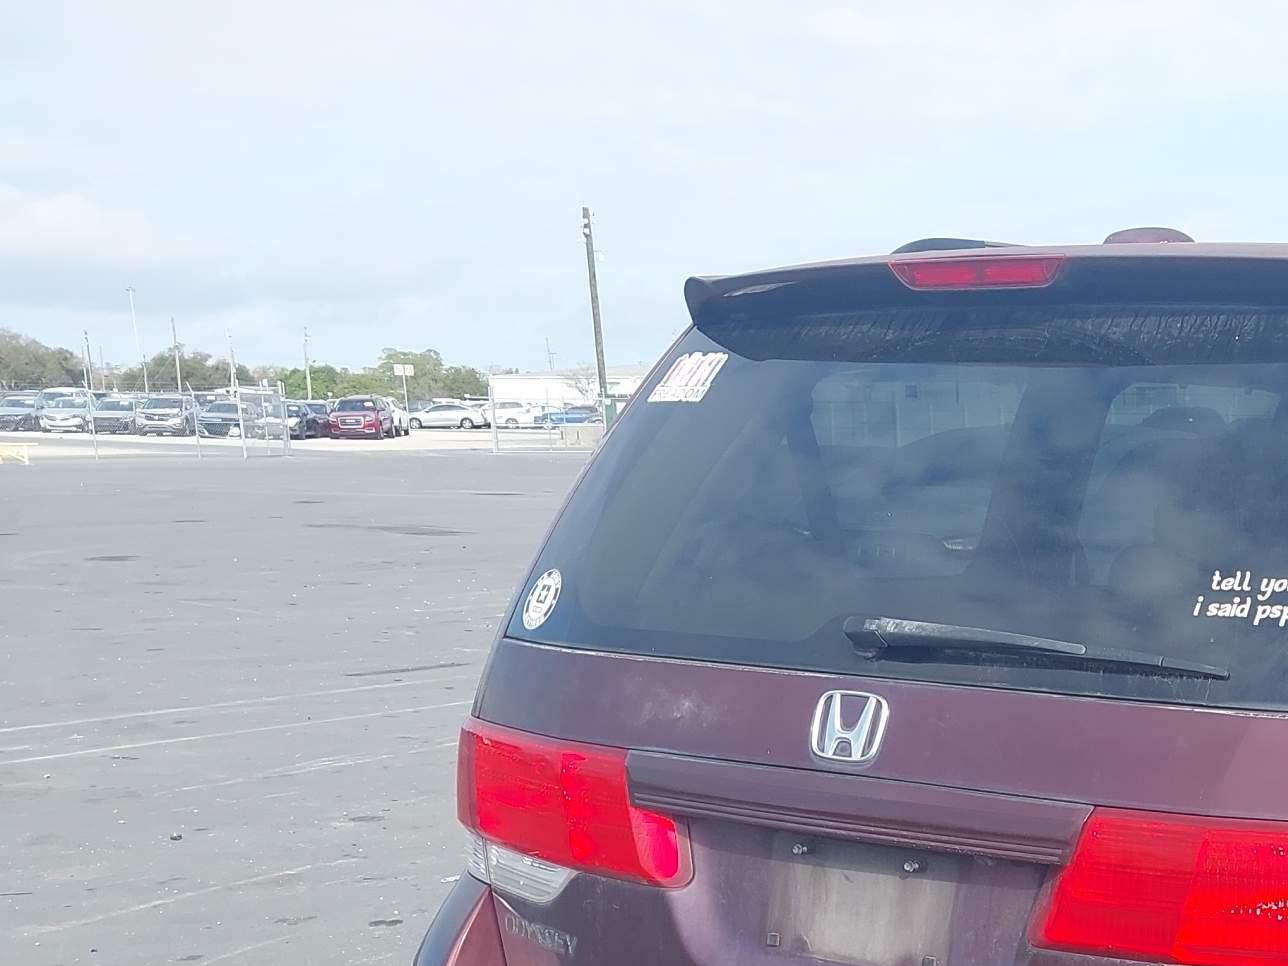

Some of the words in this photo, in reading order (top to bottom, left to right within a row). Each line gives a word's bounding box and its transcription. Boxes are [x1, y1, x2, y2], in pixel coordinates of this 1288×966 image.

[1211, 570, 1250, 591] tell
[1193, 596, 1204, 616] i
[1206, 597, 1251, 618] said
